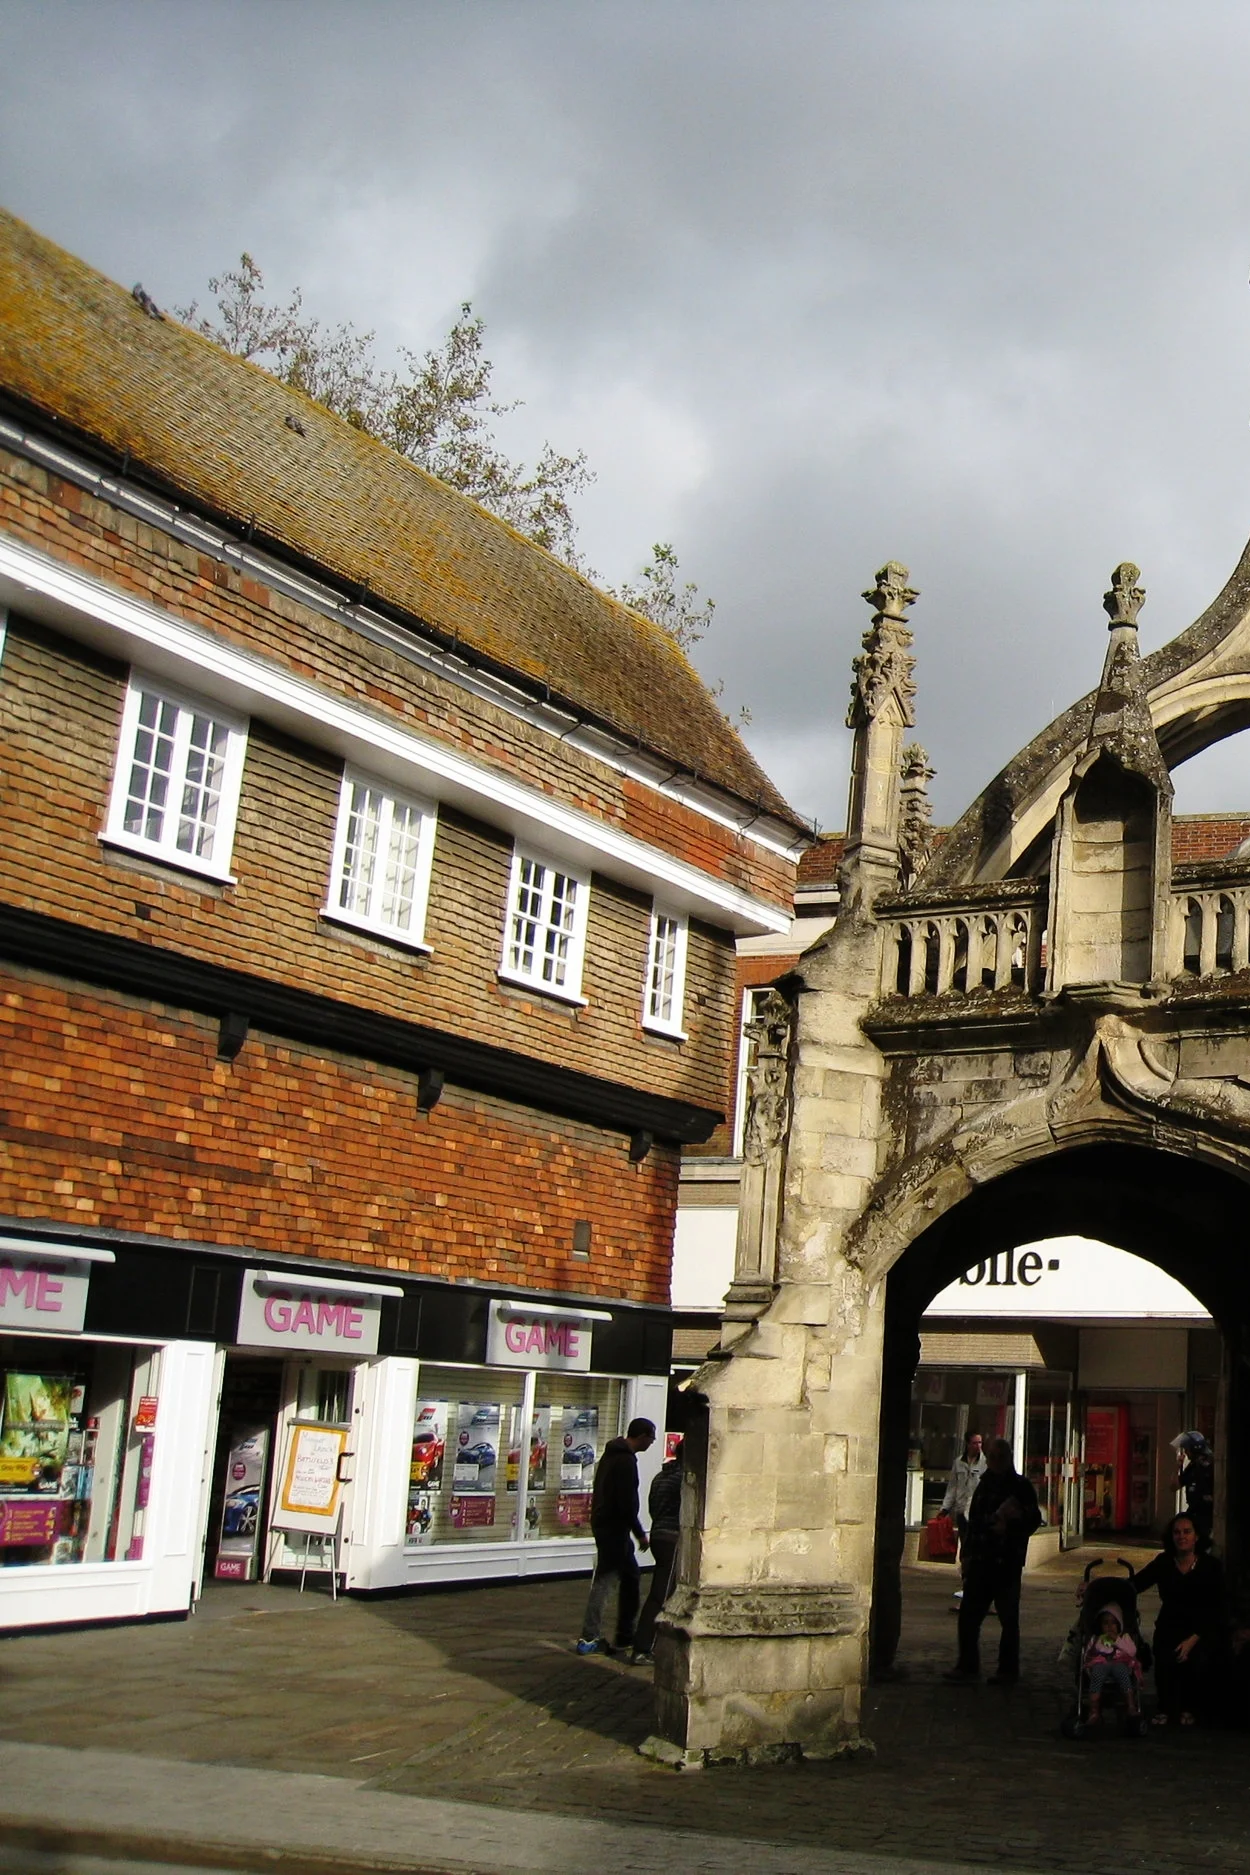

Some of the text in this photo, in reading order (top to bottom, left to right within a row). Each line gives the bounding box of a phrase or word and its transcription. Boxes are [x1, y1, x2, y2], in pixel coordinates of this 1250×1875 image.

[264, 1289, 364, 1338] GAME
[505, 1316, 580, 1357] GAME
[220, 1562, 241, 1571] GAME
